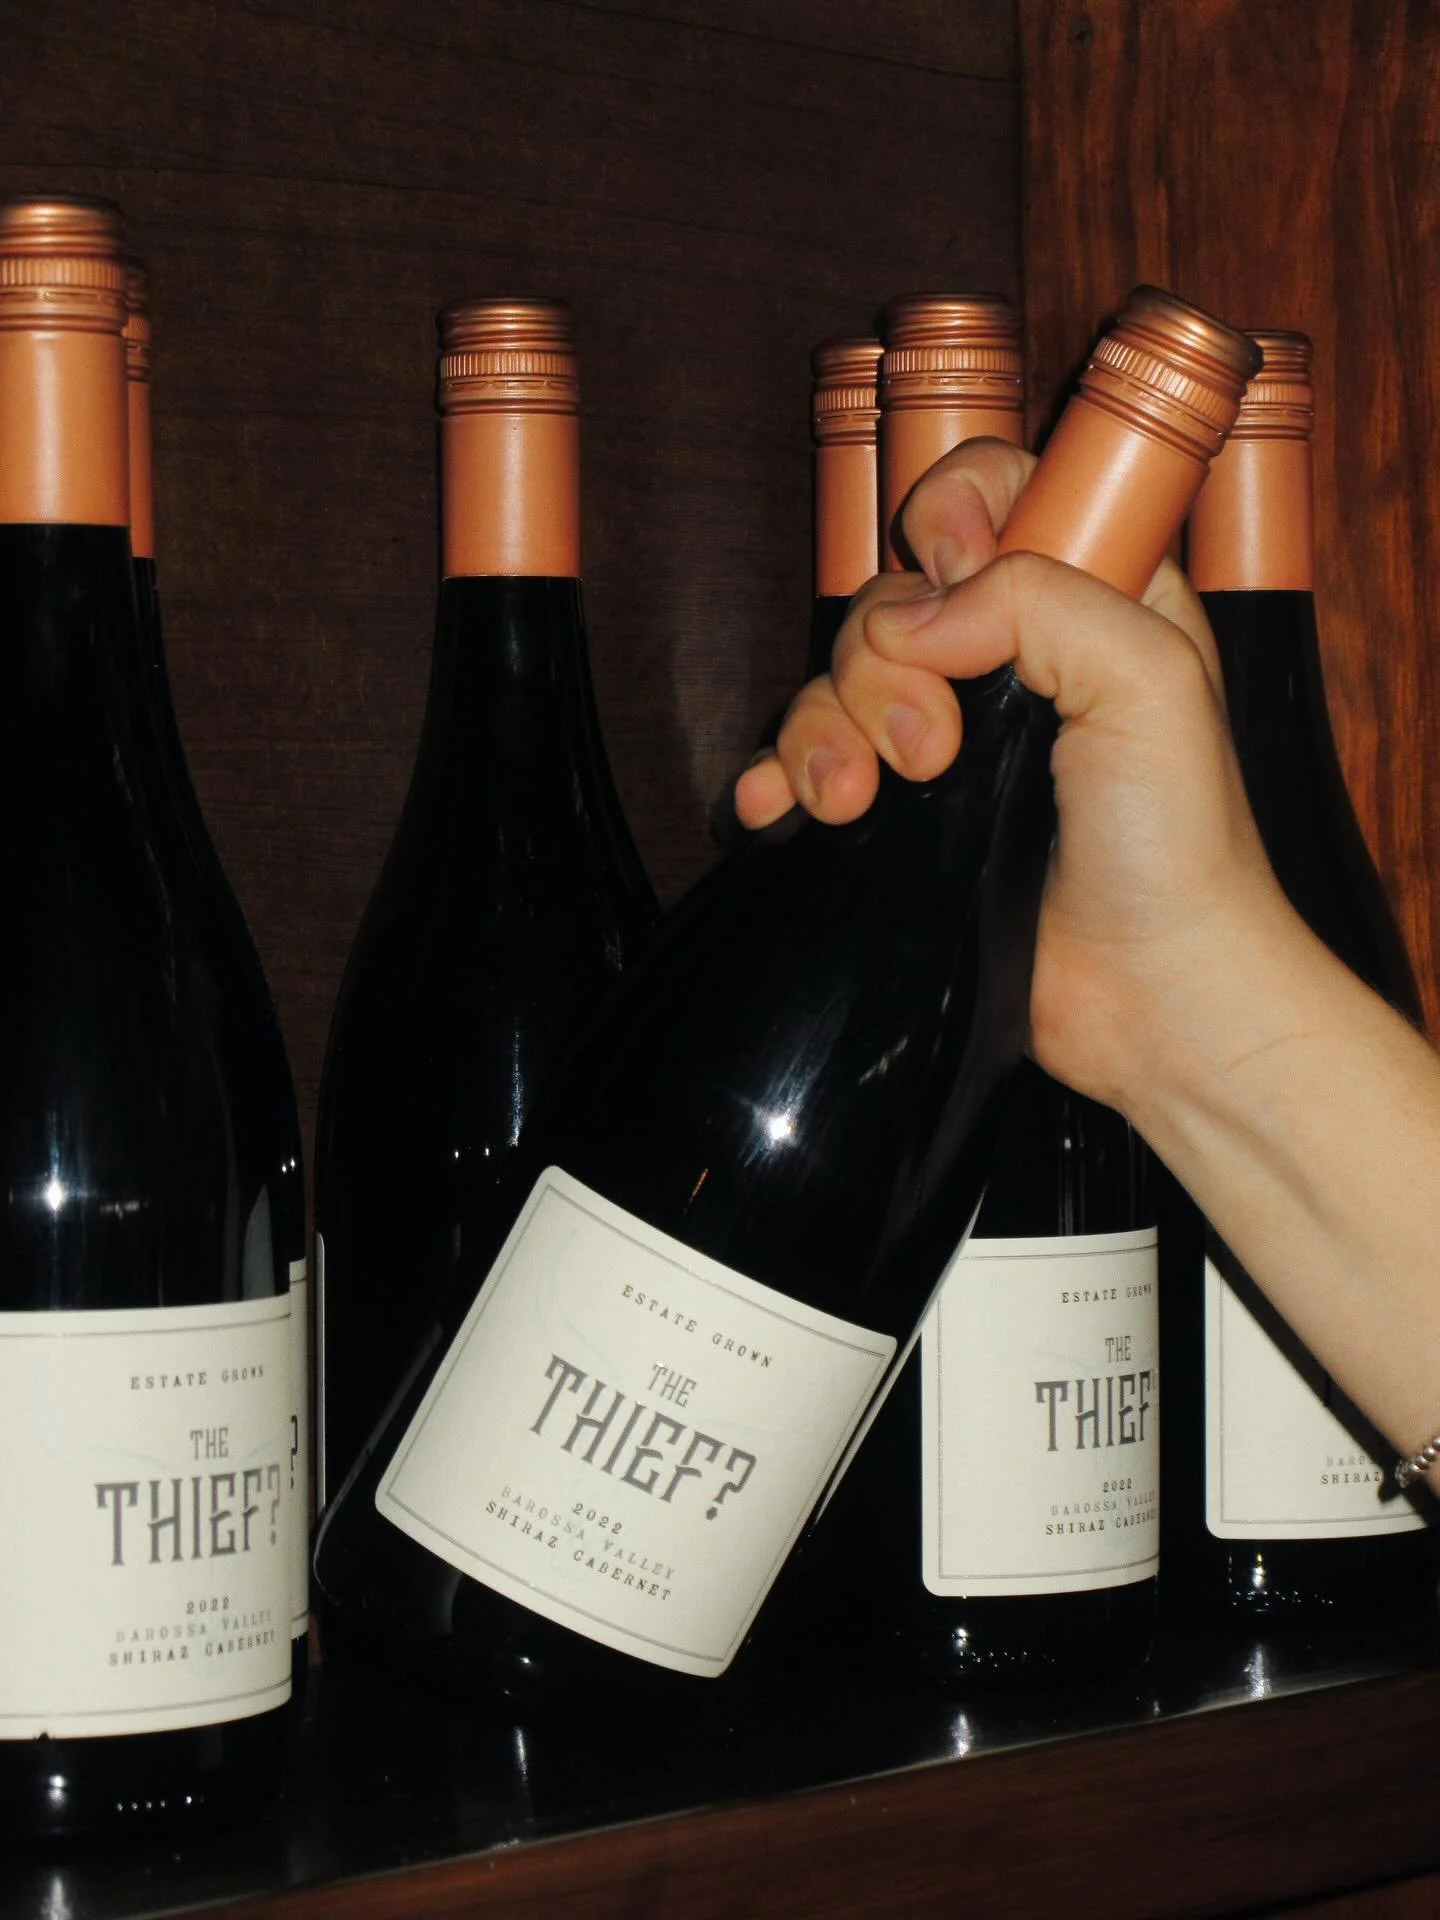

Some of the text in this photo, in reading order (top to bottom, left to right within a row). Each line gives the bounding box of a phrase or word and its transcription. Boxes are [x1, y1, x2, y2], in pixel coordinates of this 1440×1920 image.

[1061, 1287, 1118, 1304] ESTATE
[621, 1284, 773, 1369] ESTATE GROWN
[1104, 1335, 1132, 1364] THE
[130, 1371, 208, 1391] ESTATE
[647, 1363, 698, 1409] THE
[189, 1426, 230, 1462] THE
[529, 1353, 757, 1521] THIEF?
[1102, 1478, 1133, 1494] 2022
[1320, 1470, 1381, 1485] SHIRAZ
[94, 1462, 281, 1567] THIEF?
[572, 1502, 623, 1536] 2022
[1050, 1501, 1118, 1517] BAROSSA
[501, 1485, 676, 1581] BAROSSA VALLEY
[1045, 1519, 1106, 1536] SHIRAZ
[485, 1500, 672, 1601] SHIRAZ CABERNET
[186, 1596, 230, 1615] 2022
[108, 1628, 276, 1667] SHIRAZ CABERNET
[115, 1623, 208, 1644] BAROSSA
